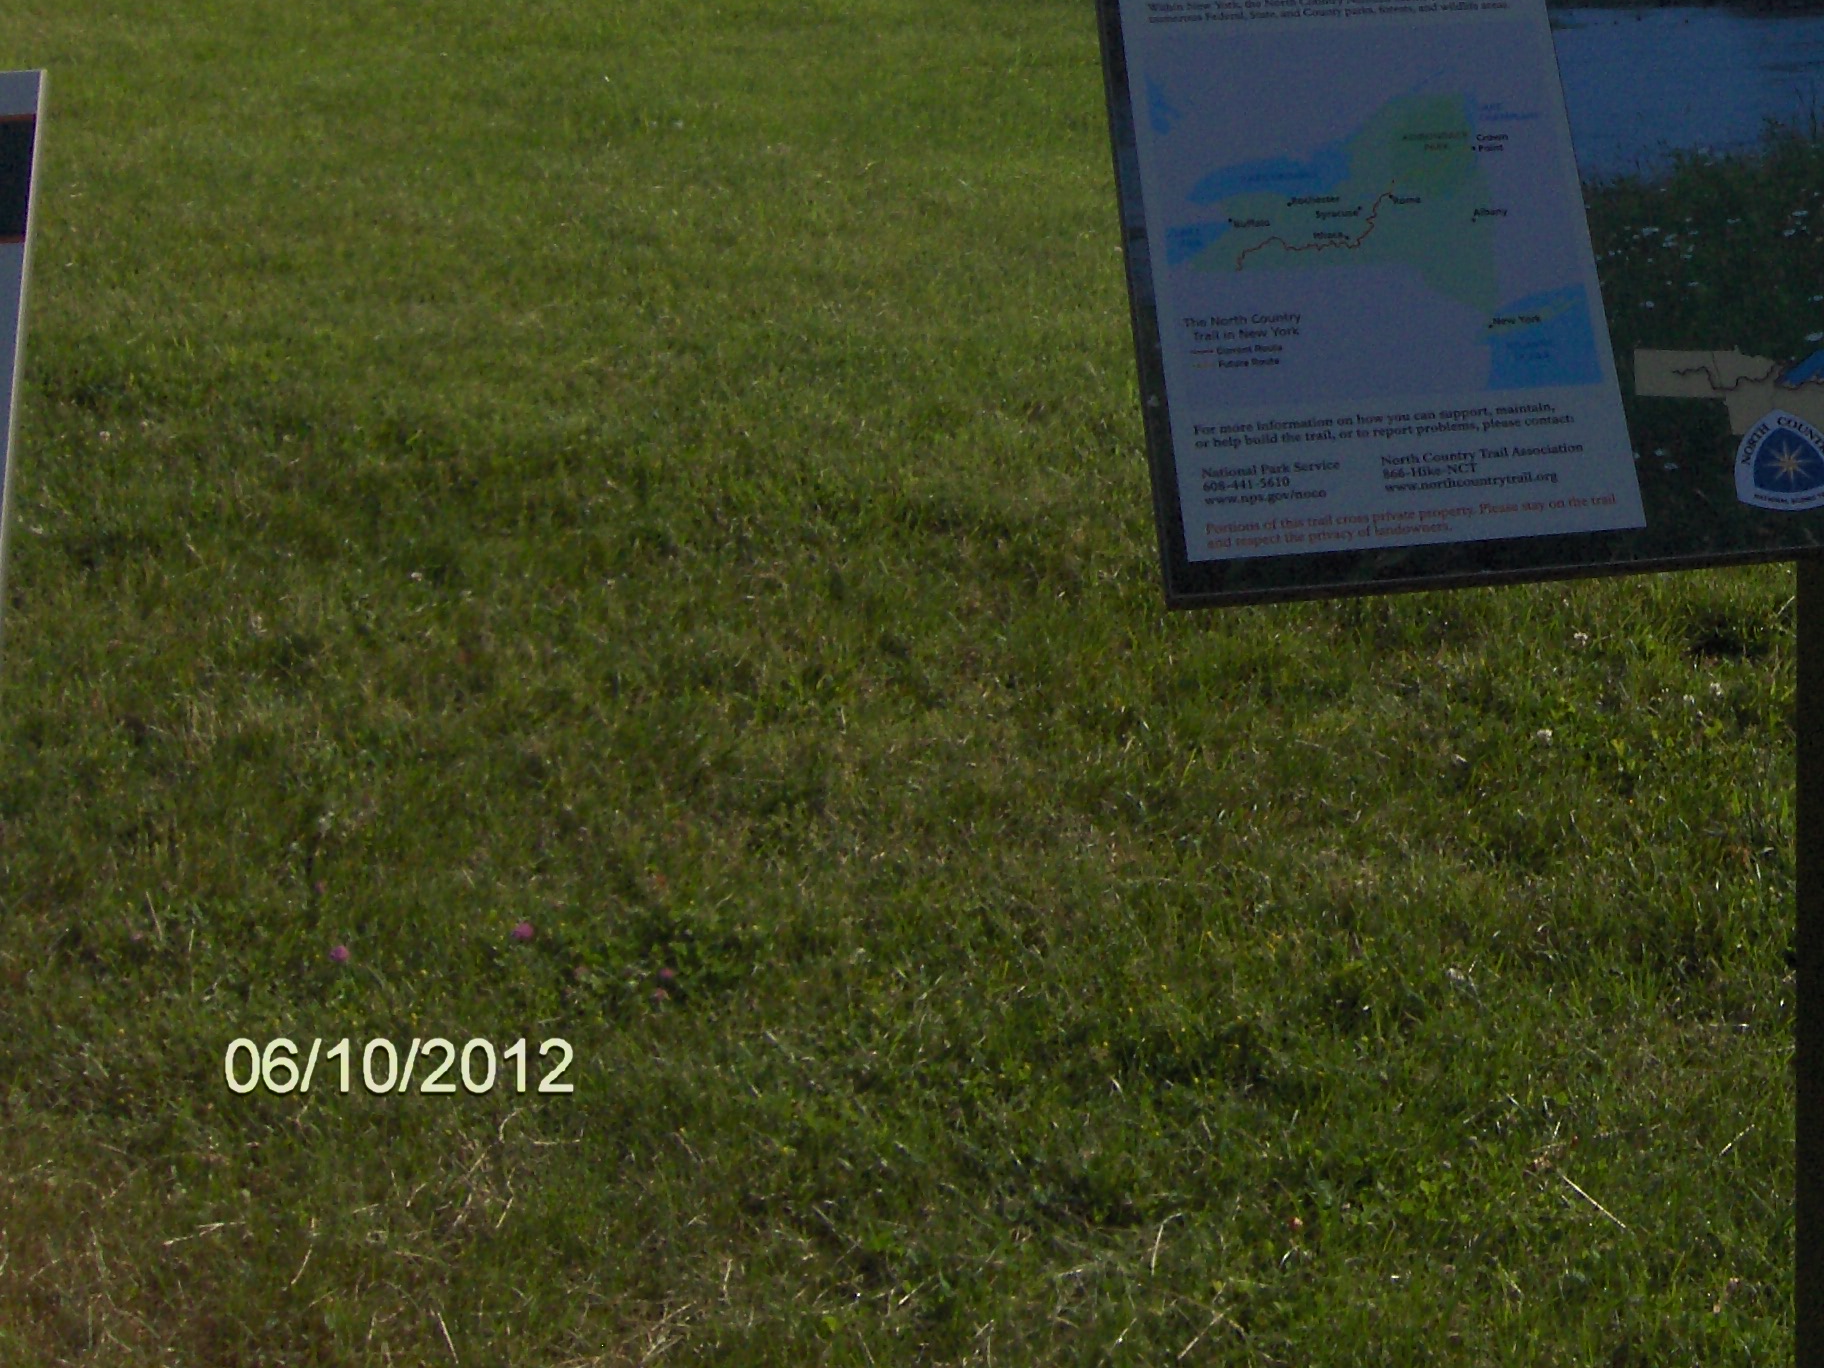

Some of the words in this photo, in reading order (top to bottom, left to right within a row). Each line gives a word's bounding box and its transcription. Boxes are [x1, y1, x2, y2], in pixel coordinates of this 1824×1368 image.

[1148, 1, 1184, 13] Within
[1186, 0, 1211, 12] New
[1205, 10, 1248, 23] Federal,
[1280, 8, 1301, 18] and
[1302, 6, 1342, 19] County
[1344, 5, 1376, 17] parks,
[1418, 2, 1438, 12] and
[1440, 1, 1479, 12] wildlife
[1478, 144, 1504, 152] Point
[1291, 196, 1340, 205] Rochester
[1393, 196, 1422, 205] Rome
[1315, 209, 1358, 220] Syracuse
[1473, 207, 1508, 218] Albany
[1233, 218, 1271, 228] Buffalo
[1183, 316, 1207, 328] The
[1211, 315, 1248, 327] North
[1251, 312, 1301, 325] Country
[1493, 317, 1516, 325] New
[1518, 314, 1541, 323] York
[1194, 330, 1219, 341] Trail
[1223, 330, 1235, 340] in
[1238, 329, 1268, 339] New
[1271, 326, 1300, 337] York
[1218, 359, 1249, 369] Future
[1251, 357, 1281, 367] Route
[1193, 424, 1216, 435] For
[1219, 423, 1254, 434] more
[1256, 416, 1334, 431] information
[1337, 416, 1353, 426] on
[1356, 413, 1384, 424] how
[1386, 413, 1410, 425] you
[1414, 411, 1436, 421] can
[1438, 406, 1491, 421] support,
[1495, 403, 1555, 416] maintain,
[1195, 439, 1208, 449] or
[1212, 435, 1242, 449] help
[1245, 433, 1278, 446] build
[1281, 432, 1301, 443] the
[1305, 429, 1336, 442] trail,
[1339, 429, 1353, 439] or
[1356, 428, 1370, 438] to
[1372, 425, 1413, 439] report
[1416, 419, 1480, 437] problems,
[1482, 417, 1522, 432] please
[1524, 414, 1575, 428] contact:
[1741, 423, 1770, 465] NORTH
[1381, 453, 1420, 466] North
[1422, 450, 1476, 465] Country
[1479, 447, 1508, 460] Trail
[1511, 442, 1584, 458] Association
[1201, 465, 1257, 479] National
[1260, 463, 1290, 475] Park
[1293, 460, 1340, 473] Service
[1382, 462, 1478, 480] 866-Hike-NCT
[1202, 476, 1290, 493] 608-441-5610
[1384, 470, 1559, 493] www.northcountrytrail.org
[1204, 489, 1327, 506] www.nps.gov/noco
[1205, 521, 1260, 534] Portions
[1263, 518, 1277, 530] of
[1281, 517, 1304, 529] this
[1307, 514, 1333, 527] trail
[1336, 515, 1369, 526] cross
[1372, 509, 1418, 524] private
[1478, 501, 1519, 515] Please
[1522, 499, 1546, 513] stay
[1548, 499, 1565, 509] on
[1568, 496, 1589, 507] the
[1591, 492, 1616, 506] trail
[1207, 537, 1232, 549] and
[1236, 534, 1281, 548] respect
[1284, 532, 1304, 544] the
[1307, 528, 1353, 545] privacy
[1356, 525, 1371, 537] of
[1373, 521, 1452, 538] landowners.
